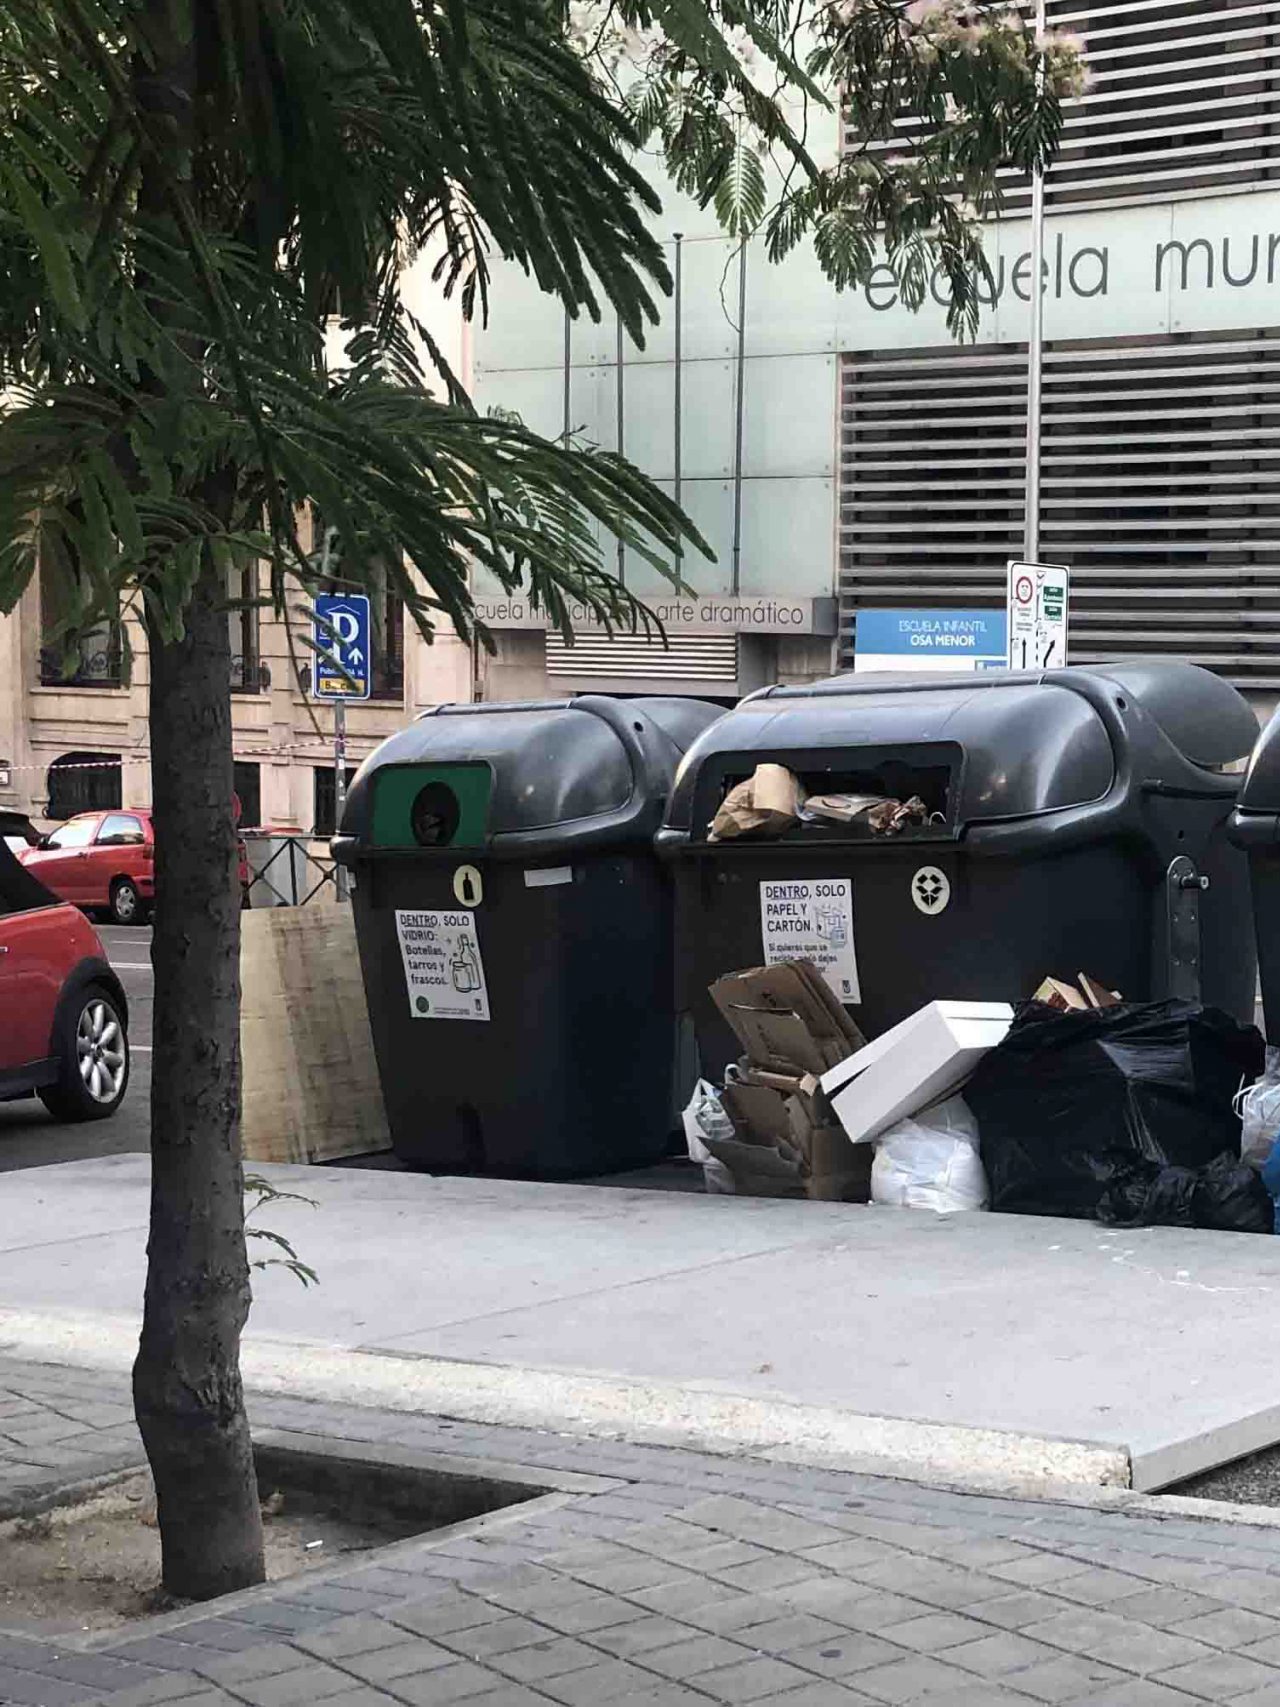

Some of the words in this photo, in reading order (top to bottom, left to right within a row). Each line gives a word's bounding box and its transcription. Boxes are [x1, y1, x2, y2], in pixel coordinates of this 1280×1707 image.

[865, 233, 1108, 311] ecuela
[466, 599, 523, 620] cuela
[656, 600, 694, 622] arte
[700, 601, 804, 625] dramático
[899, 620, 941, 632] ESCUELA
[943, 620, 987, 632] INFANTIL
[910, 634, 933, 646] OSA
[935, 634, 976, 646] MENOR
[766, 885, 812, 899] DENTRO,
[815, 884, 846, 897] SOLO
[767, 903, 798, 916] PAPEL
[800, 903, 807, 915] Y
[400, 914, 441, 927] DENTRO,
[443, 915, 470, 926] SOLO
[767, 917, 814, 933] CARTÓN.
[405, 944, 446, 957] Botellas,
[408, 959, 438, 970] tarros
[439, 963, 445, 972] y
